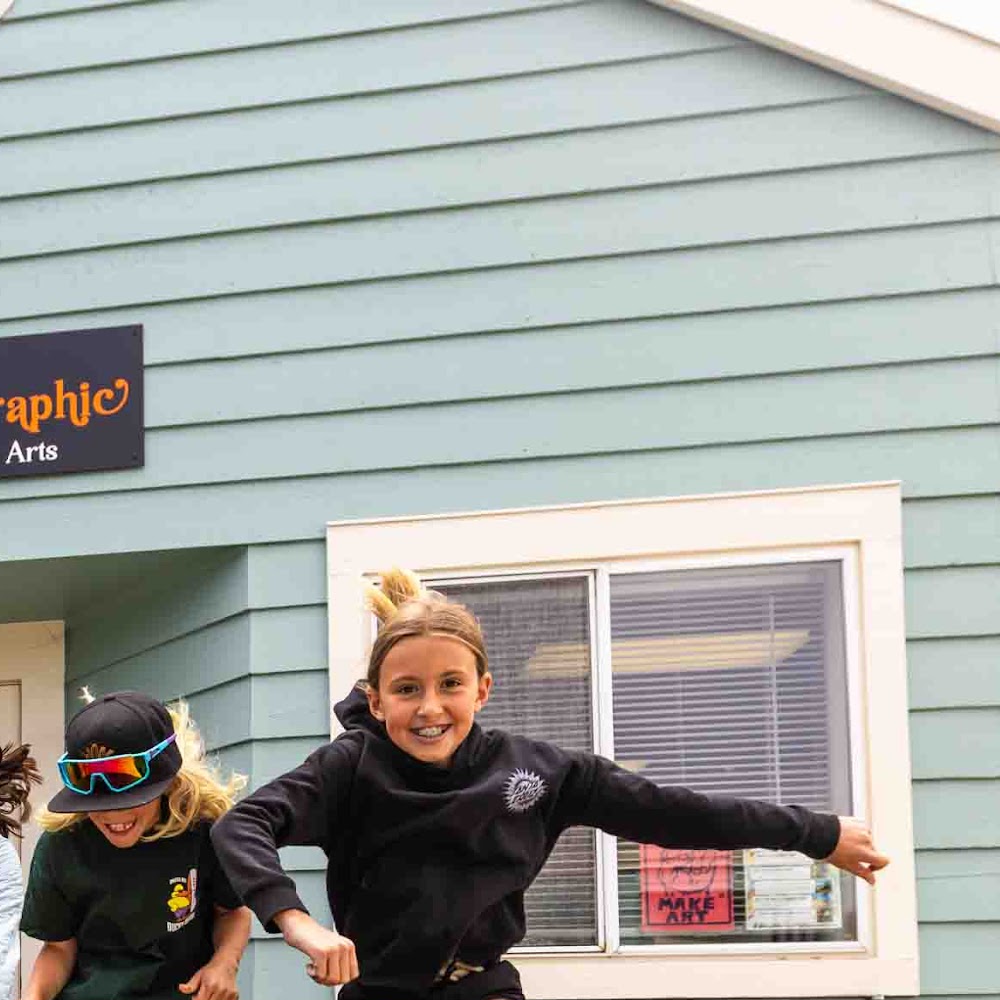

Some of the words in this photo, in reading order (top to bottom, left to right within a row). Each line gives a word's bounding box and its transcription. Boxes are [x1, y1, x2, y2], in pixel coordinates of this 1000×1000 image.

[5, 439, 59, 465] Arts
[657, 896, 715, 912] MAKE
[665, 910, 708, 924] ART
